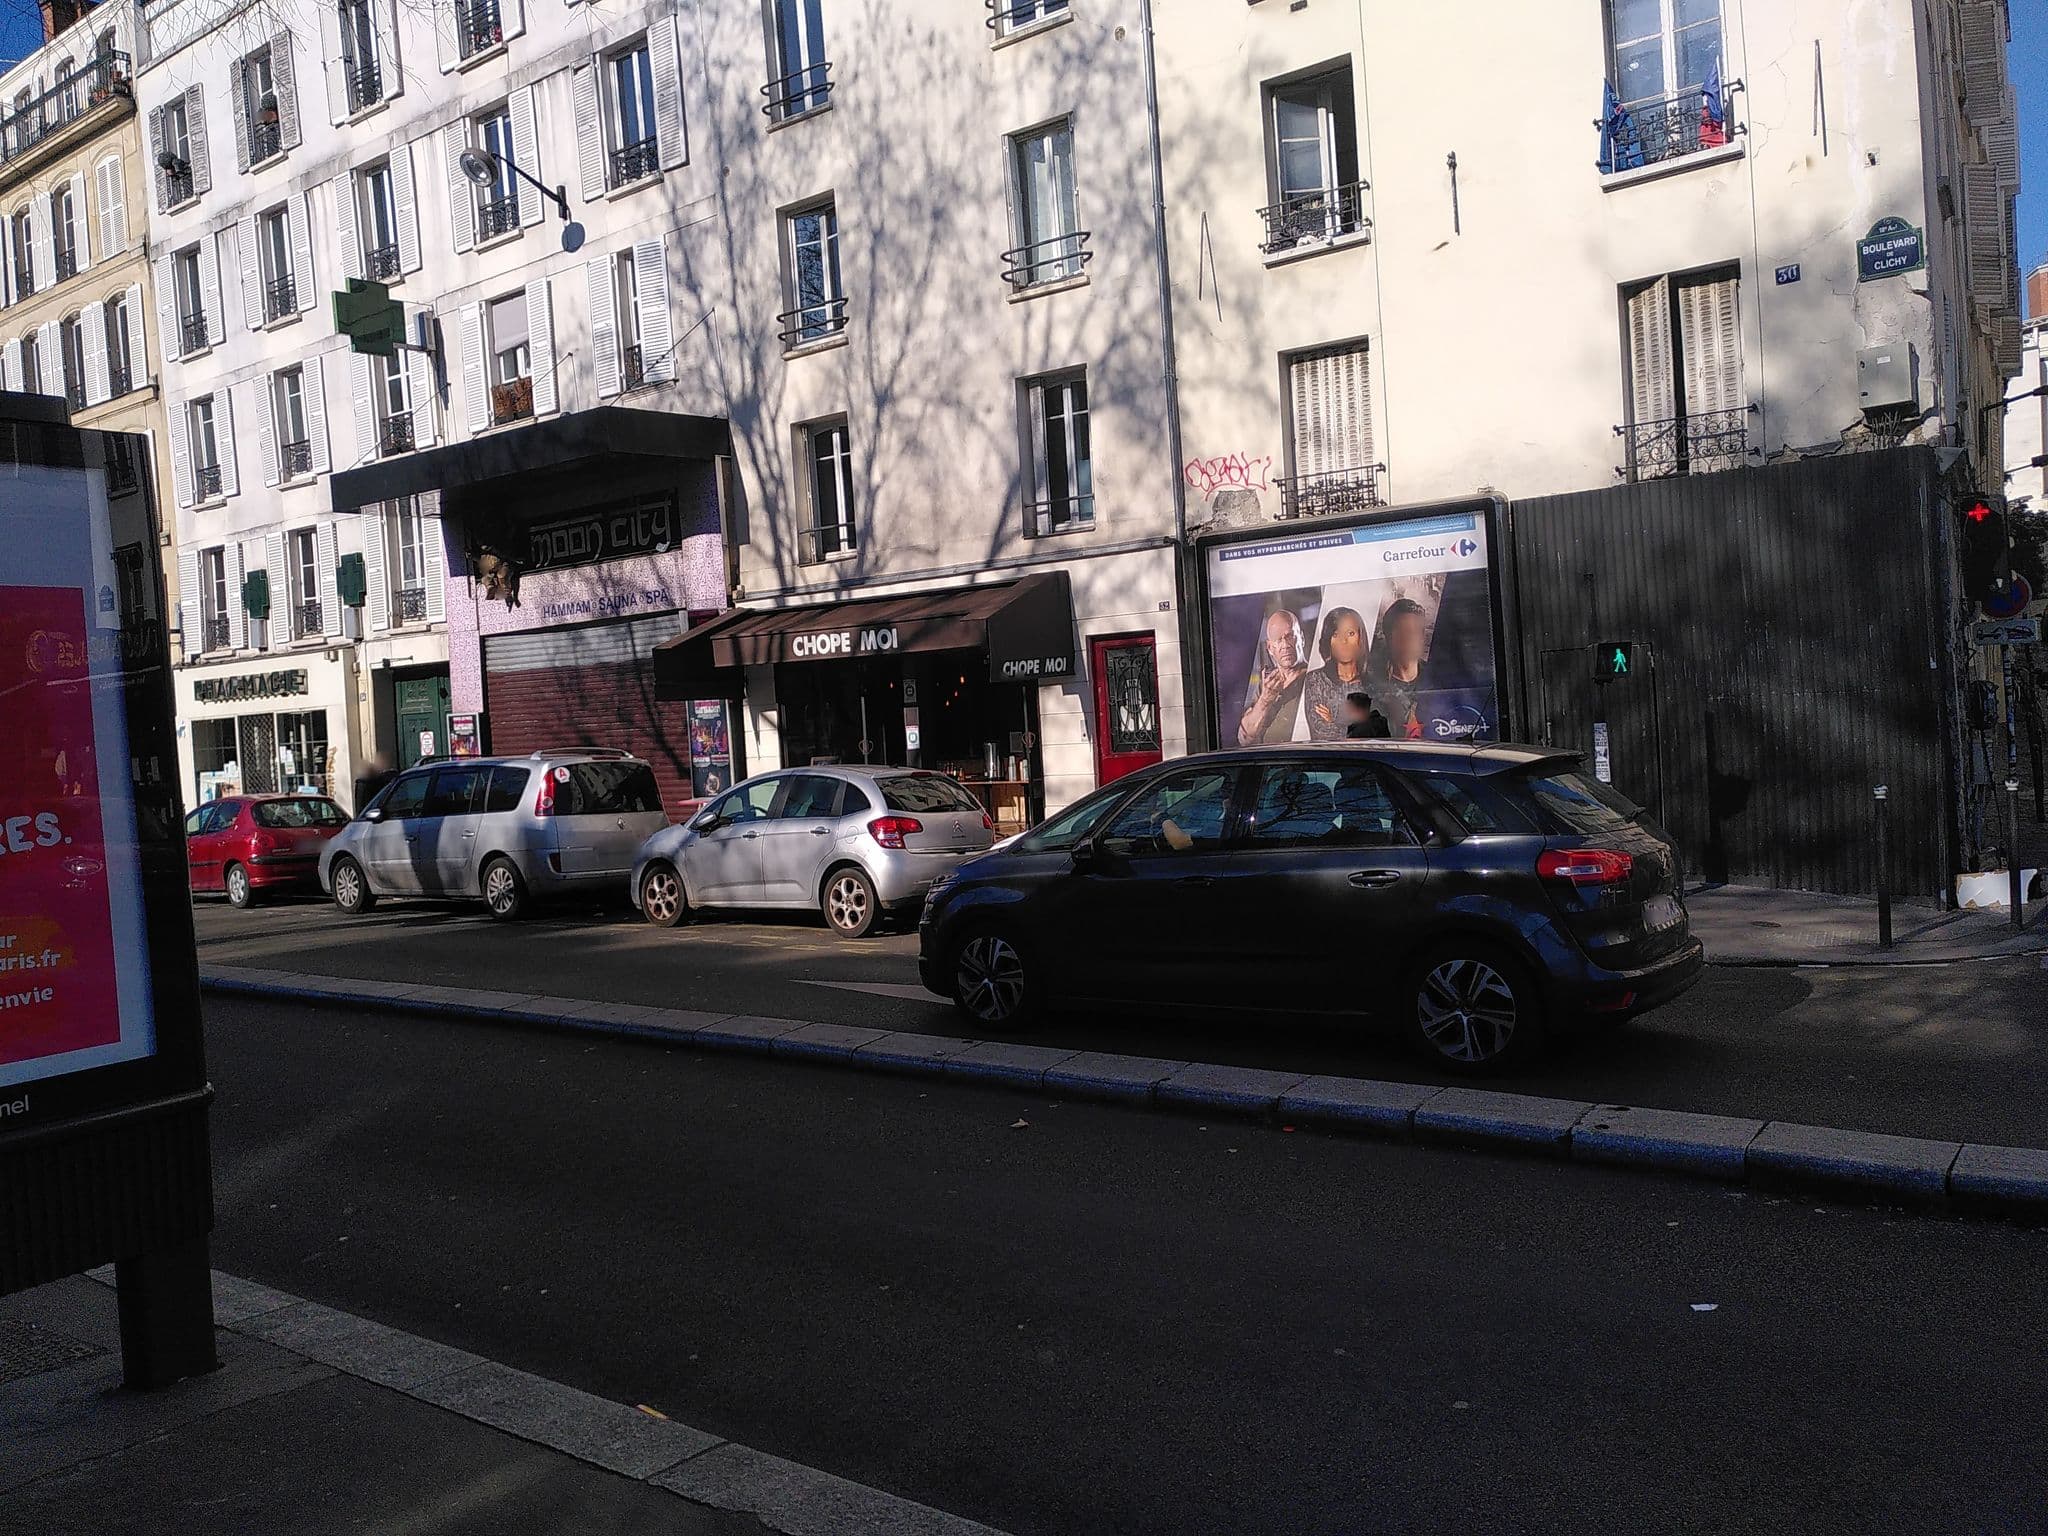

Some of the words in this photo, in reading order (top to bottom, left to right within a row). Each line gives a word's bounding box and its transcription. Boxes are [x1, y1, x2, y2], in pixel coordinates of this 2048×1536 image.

[1862, 236, 1917, 255] BOULEVARD
[1873, 255, 1908, 270] CLICHY
[1225, 551, 1242, 559] DANS
[1309, 540, 1317, 548] ET
[1319, 537, 1342, 547] DRIVES
[1383, 545, 1446, 563] Carrefour
[542, 600, 591, 619] HAMMAM
[599, 593, 638, 611] SAUNA
[645, 588, 669, 604] SPA
[792, 632, 851, 656] CHOPE
[860, 628, 898, 651] MOI
[1002, 659, 1040, 677] CHOPE
[1045, 657, 1067, 674] MOI
[0, 811, 72, 855] ES.
[0, 986, 54, 1010] nvie
